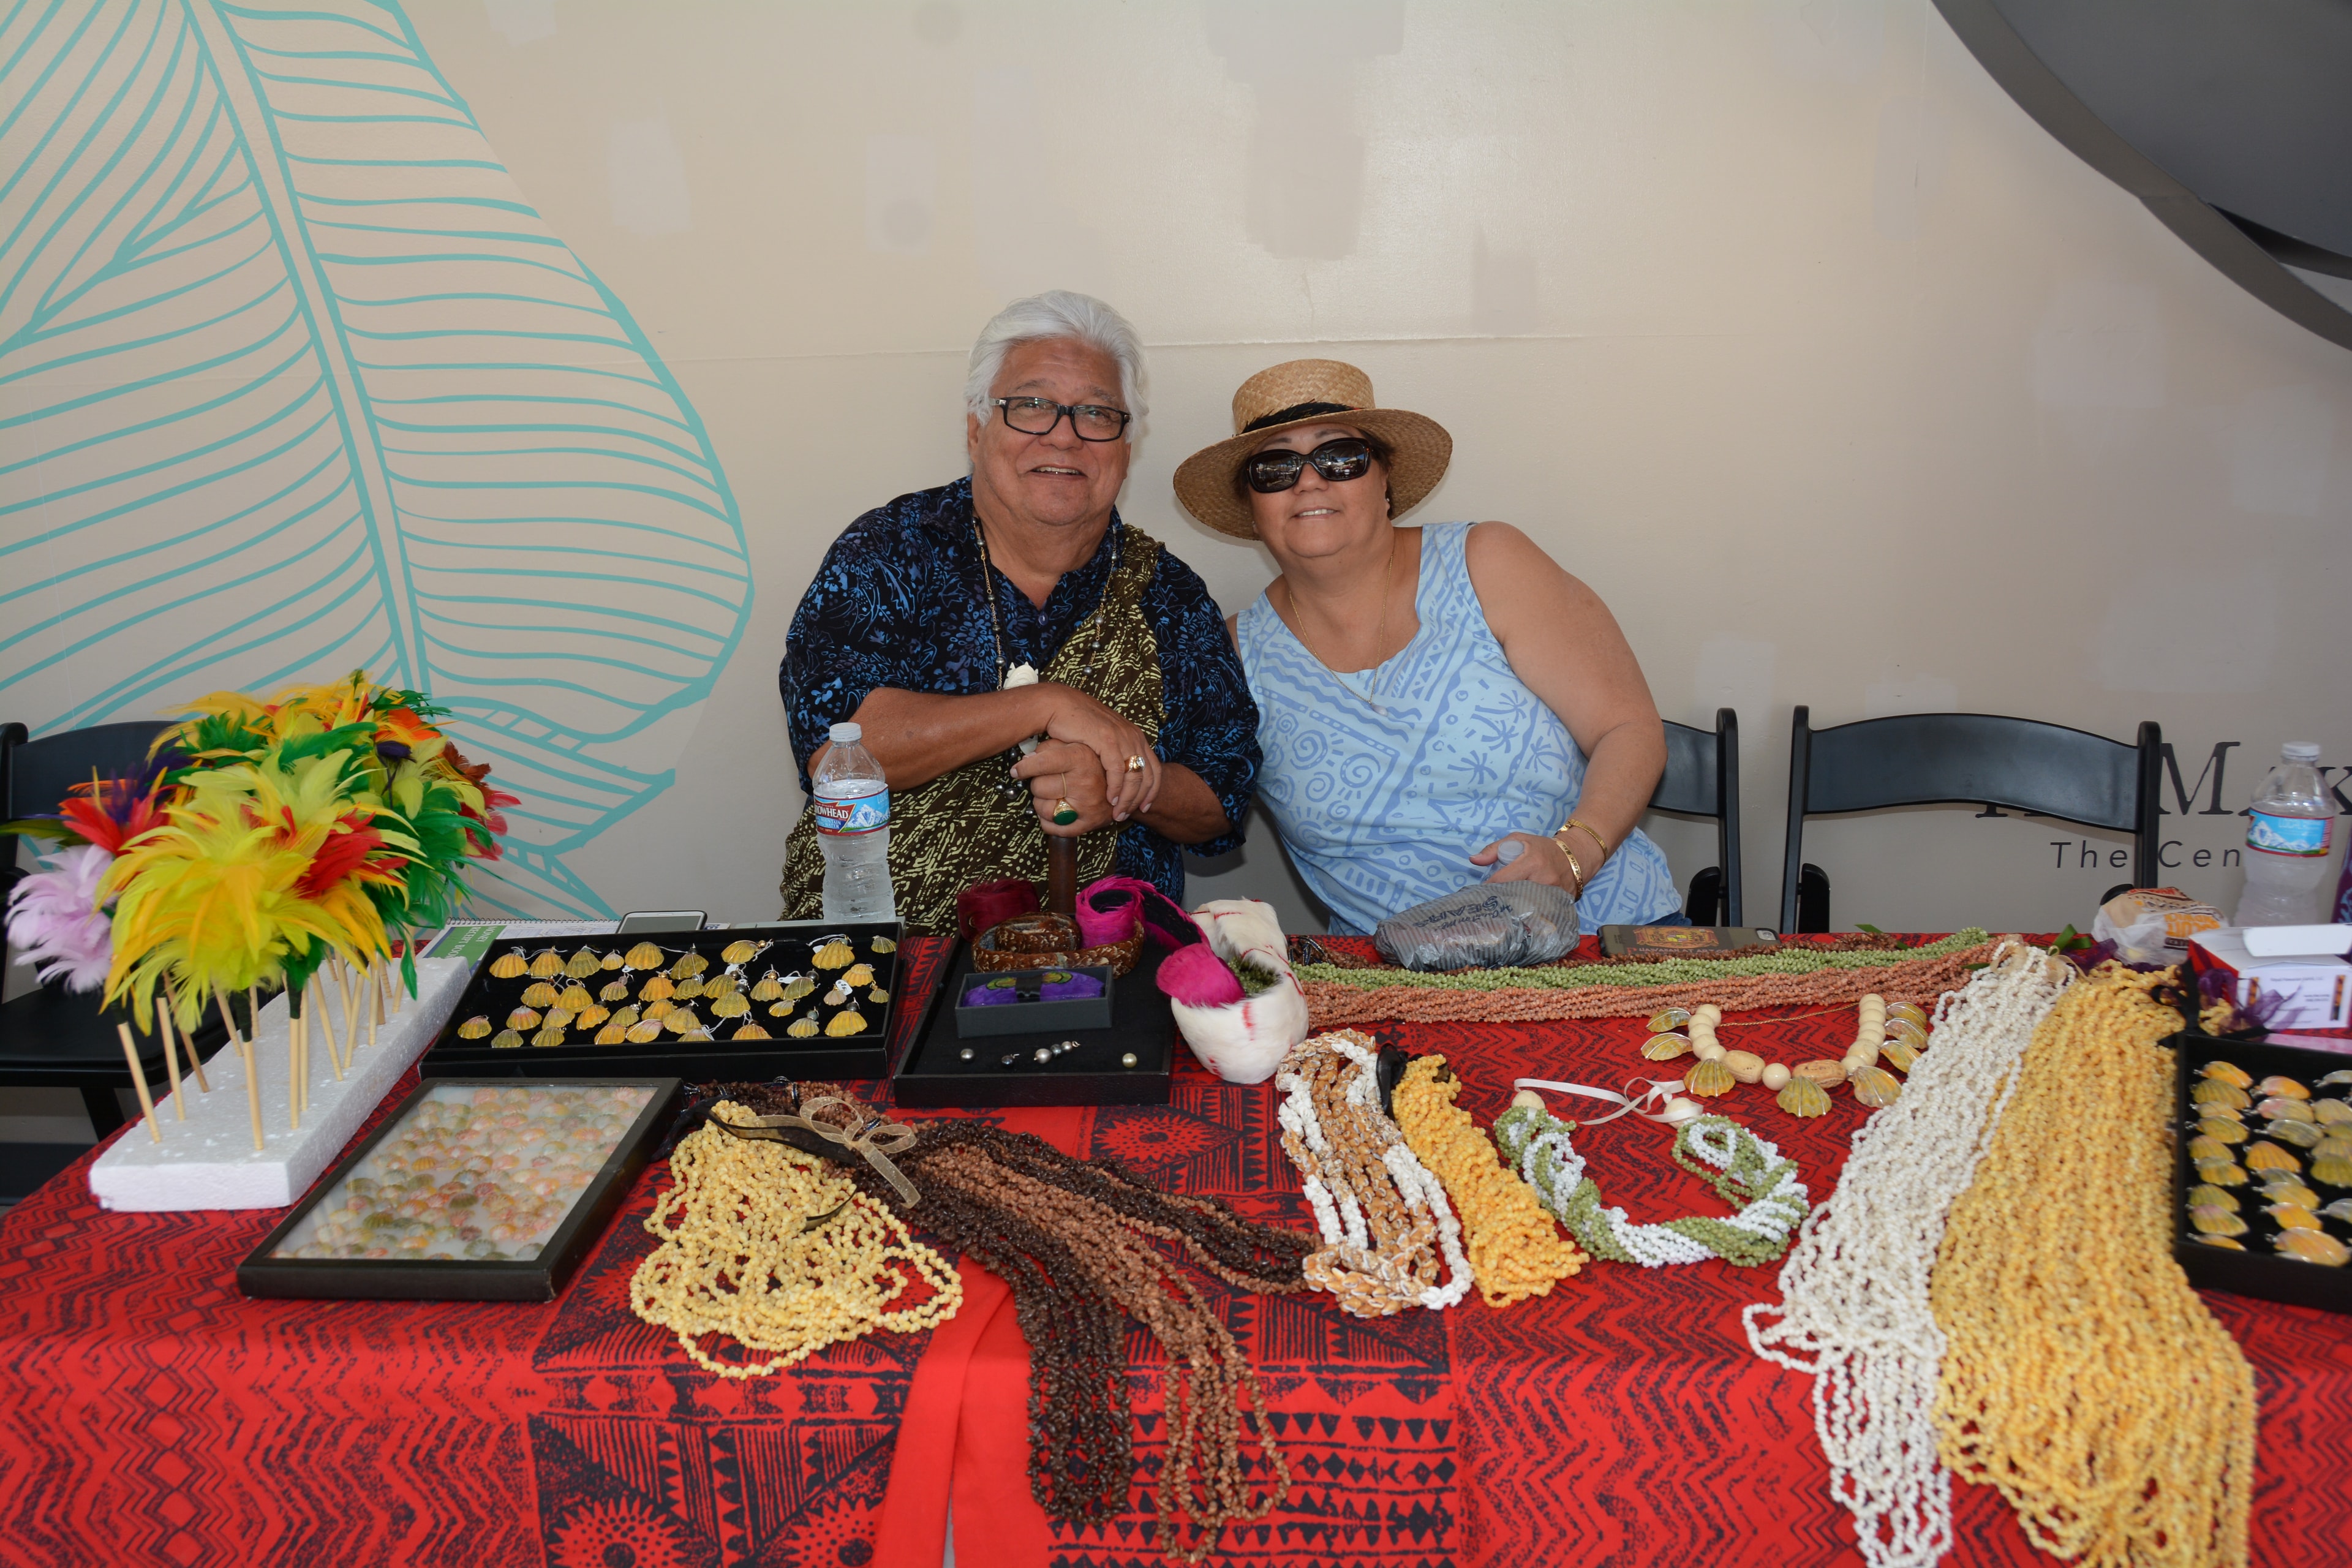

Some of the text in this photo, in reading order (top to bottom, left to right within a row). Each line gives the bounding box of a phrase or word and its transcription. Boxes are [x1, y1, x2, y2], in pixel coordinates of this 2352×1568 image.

[2050, 840, 2128, 868] The
[1413, 895, 1498, 927] SEARS
[458, 926, 481, 944] RECEIPT
[476, 926, 497, 942] MONEY
